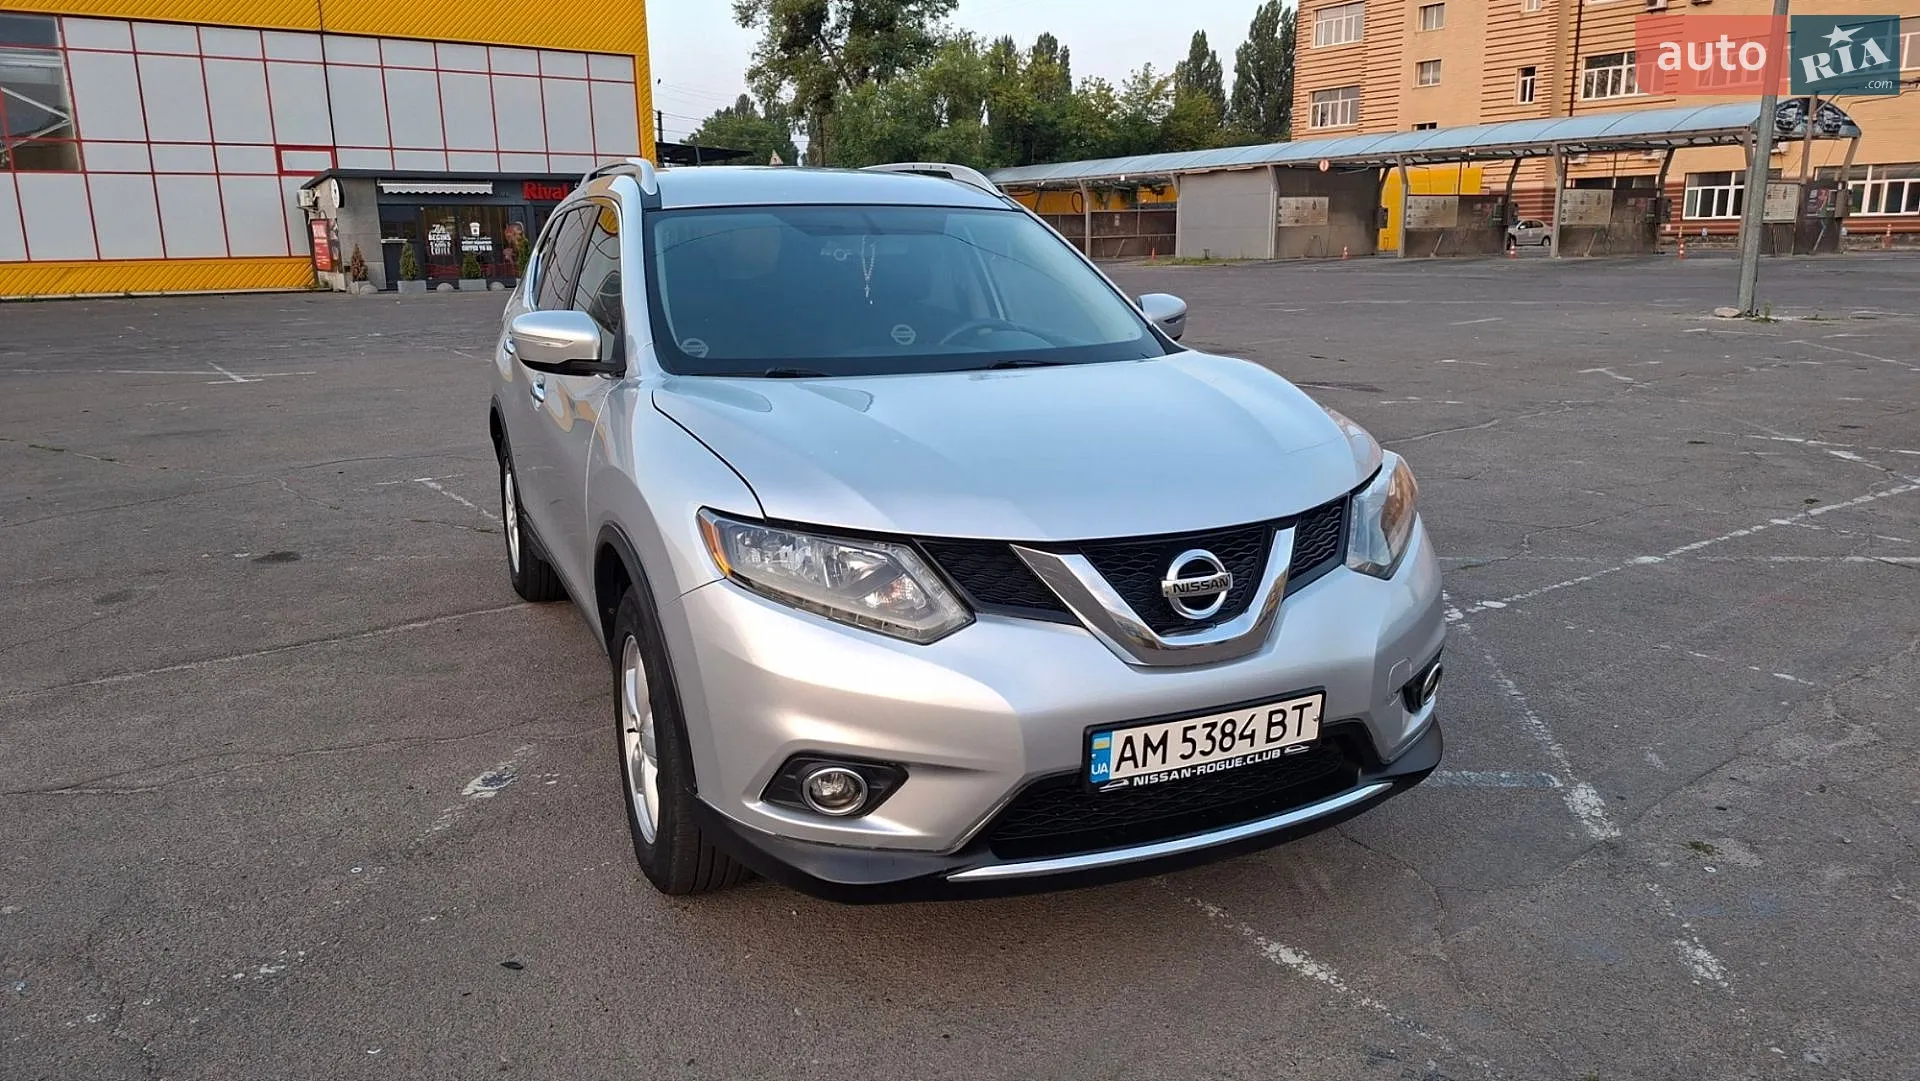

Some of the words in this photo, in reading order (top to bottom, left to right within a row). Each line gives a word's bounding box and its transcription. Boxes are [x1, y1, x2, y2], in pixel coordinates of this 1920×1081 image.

[523, 181, 568, 200] Rival
[1173, 577, 1229, 593] NISSAN
[1115, 729, 1169, 772] AM
[1179, 713, 1257, 760] 5384
[1265, 702, 1312, 744] BT
[1091, 762, 1109, 775] UA
[1133, 749, 1281, 787] NISSAN-ROGUE.CLUB
